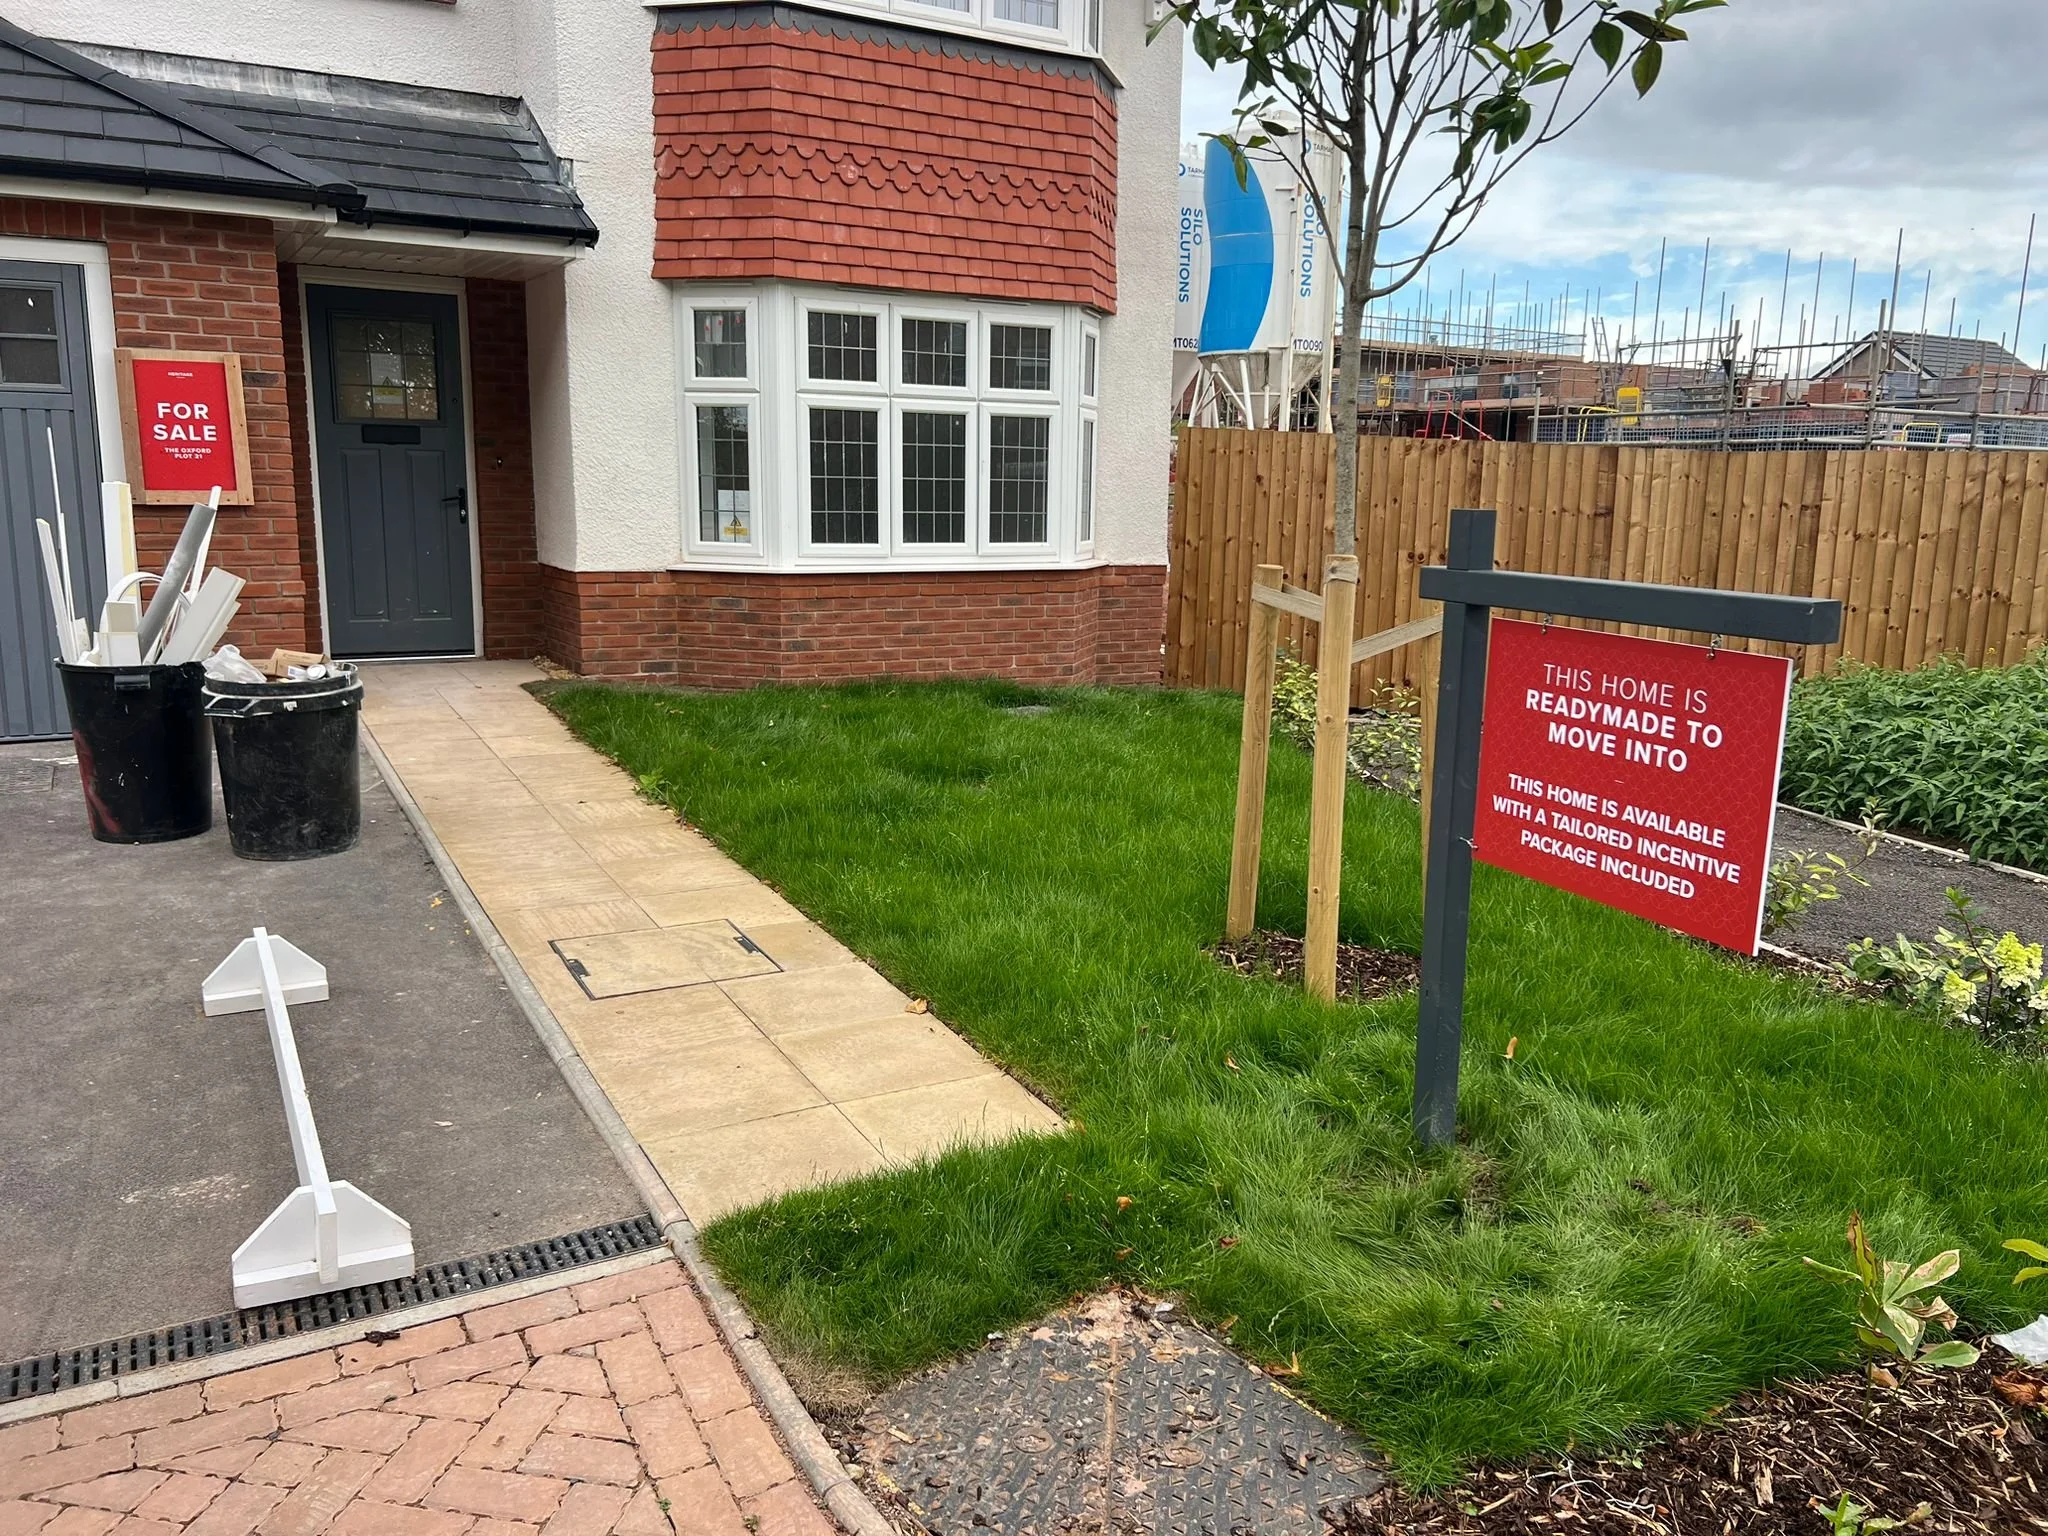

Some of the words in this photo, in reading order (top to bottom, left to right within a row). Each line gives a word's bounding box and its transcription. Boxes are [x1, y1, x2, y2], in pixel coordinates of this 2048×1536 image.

[1193, 208, 1203, 246] SILO
[1316, 195, 1327, 236] SO
[1178, 207, 1192, 303] SOLUTIONS
[1300, 193, 1315, 297] SOLUTIONS
[153, 424, 217, 441] SALE
[157, 402, 209, 420] FOR
[1544, 664, 1591, 691] THIS
[1602, 675, 1674, 707] HOME
[1685, 688, 1707, 713] IS
[1526, 689, 1676, 739] READYMADE
[1687, 720, 1723, 748] TO
[1548, 722, 1615, 756] MOVE
[1625, 739, 1688, 772] INTO
[1508, 774, 1542, 797] THIS
[1547, 783, 1597, 812] HOME
[1602, 799, 1618, 818] IS
[1622, 805, 1725, 848] AVAILABLE
[1492, 795, 1532, 821] WITH
[1535, 808, 1547, 825] A
[1551, 812, 1632, 850] TAILORED
[1638, 837, 1740, 883] INCENTIVE
[1521, 829, 1596, 868] PACKAGE
[1601, 855, 1694, 899] INCLUDED
